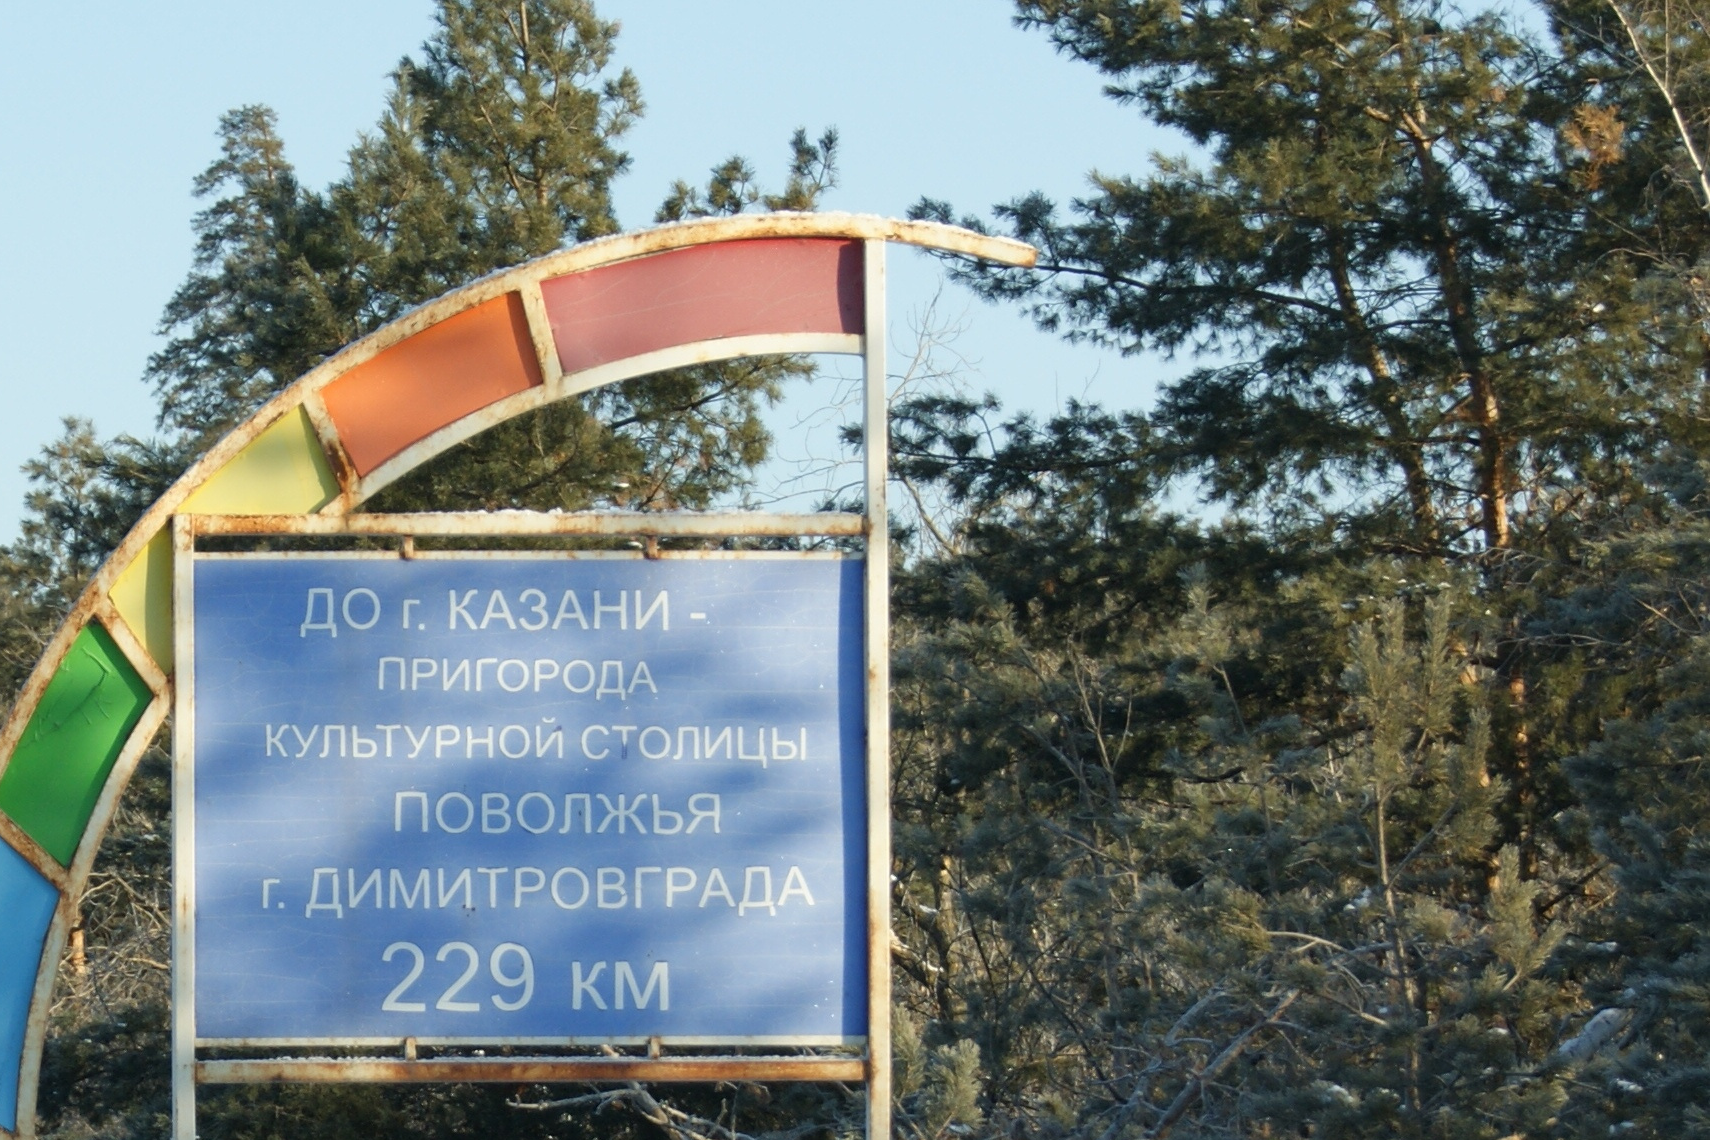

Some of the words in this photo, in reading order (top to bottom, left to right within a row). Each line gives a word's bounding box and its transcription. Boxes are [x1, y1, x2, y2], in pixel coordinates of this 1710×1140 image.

[300, 587, 382, 638] ДО
[402, 598, 427, 632] г.
[449, 588, 670, 632] КАЗАНИ
[377, 657, 657, 700] ПРИГОРОДА
[265, 716, 565, 760] КУЛЬТУРНОЙ
[580, 725, 808, 768] СТОЛИЦЫ
[394, 791, 721, 835] ПОВОЛЖЬЯ
[262, 877, 286, 910] г.
[305, 866, 815, 918] ДИМИТРОВГРАДА
[381, 941, 535, 1012] 229
